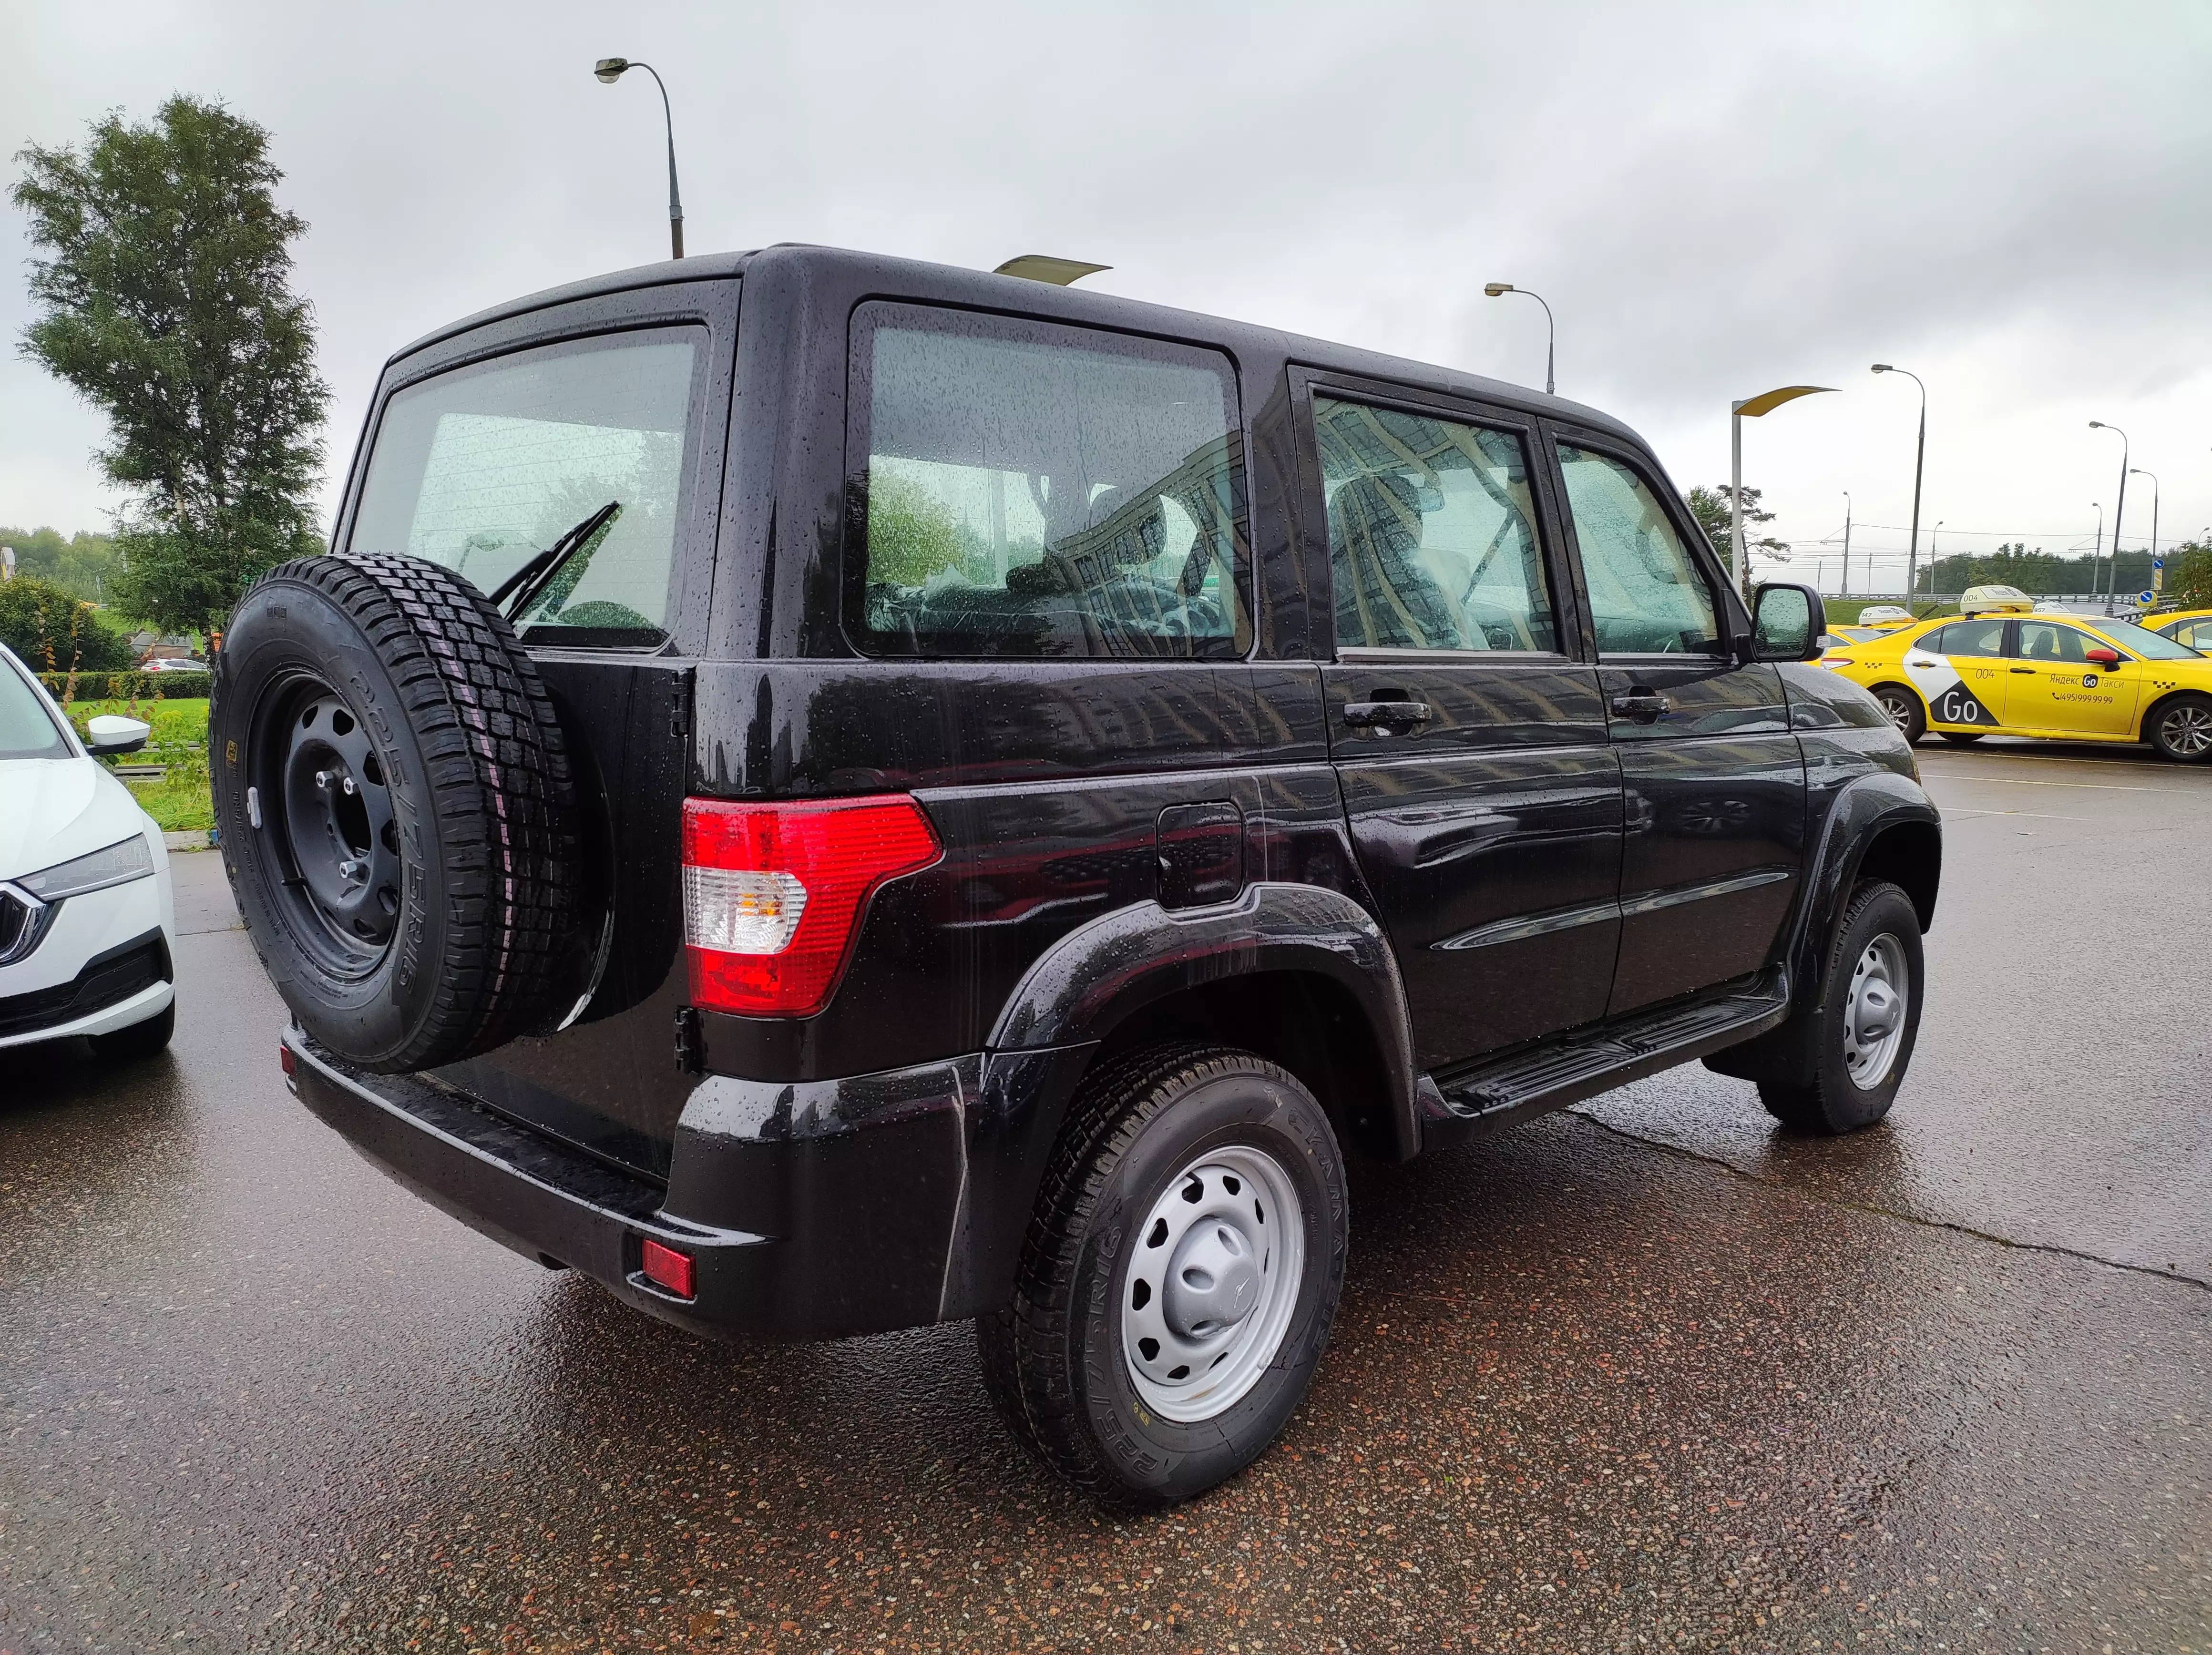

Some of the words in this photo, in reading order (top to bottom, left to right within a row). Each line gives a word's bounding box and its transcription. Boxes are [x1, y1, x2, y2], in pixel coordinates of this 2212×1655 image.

[1976, 668, 1995, 679] 004
[2049, 674, 2080, 685] Яндекс
[2084, 675, 2096, 686] Go
[2100, 676, 2125, 688] Такси
[1944, 691, 1978, 722] Go
[1085, 1225, 1157, 1477] 225/75R16
